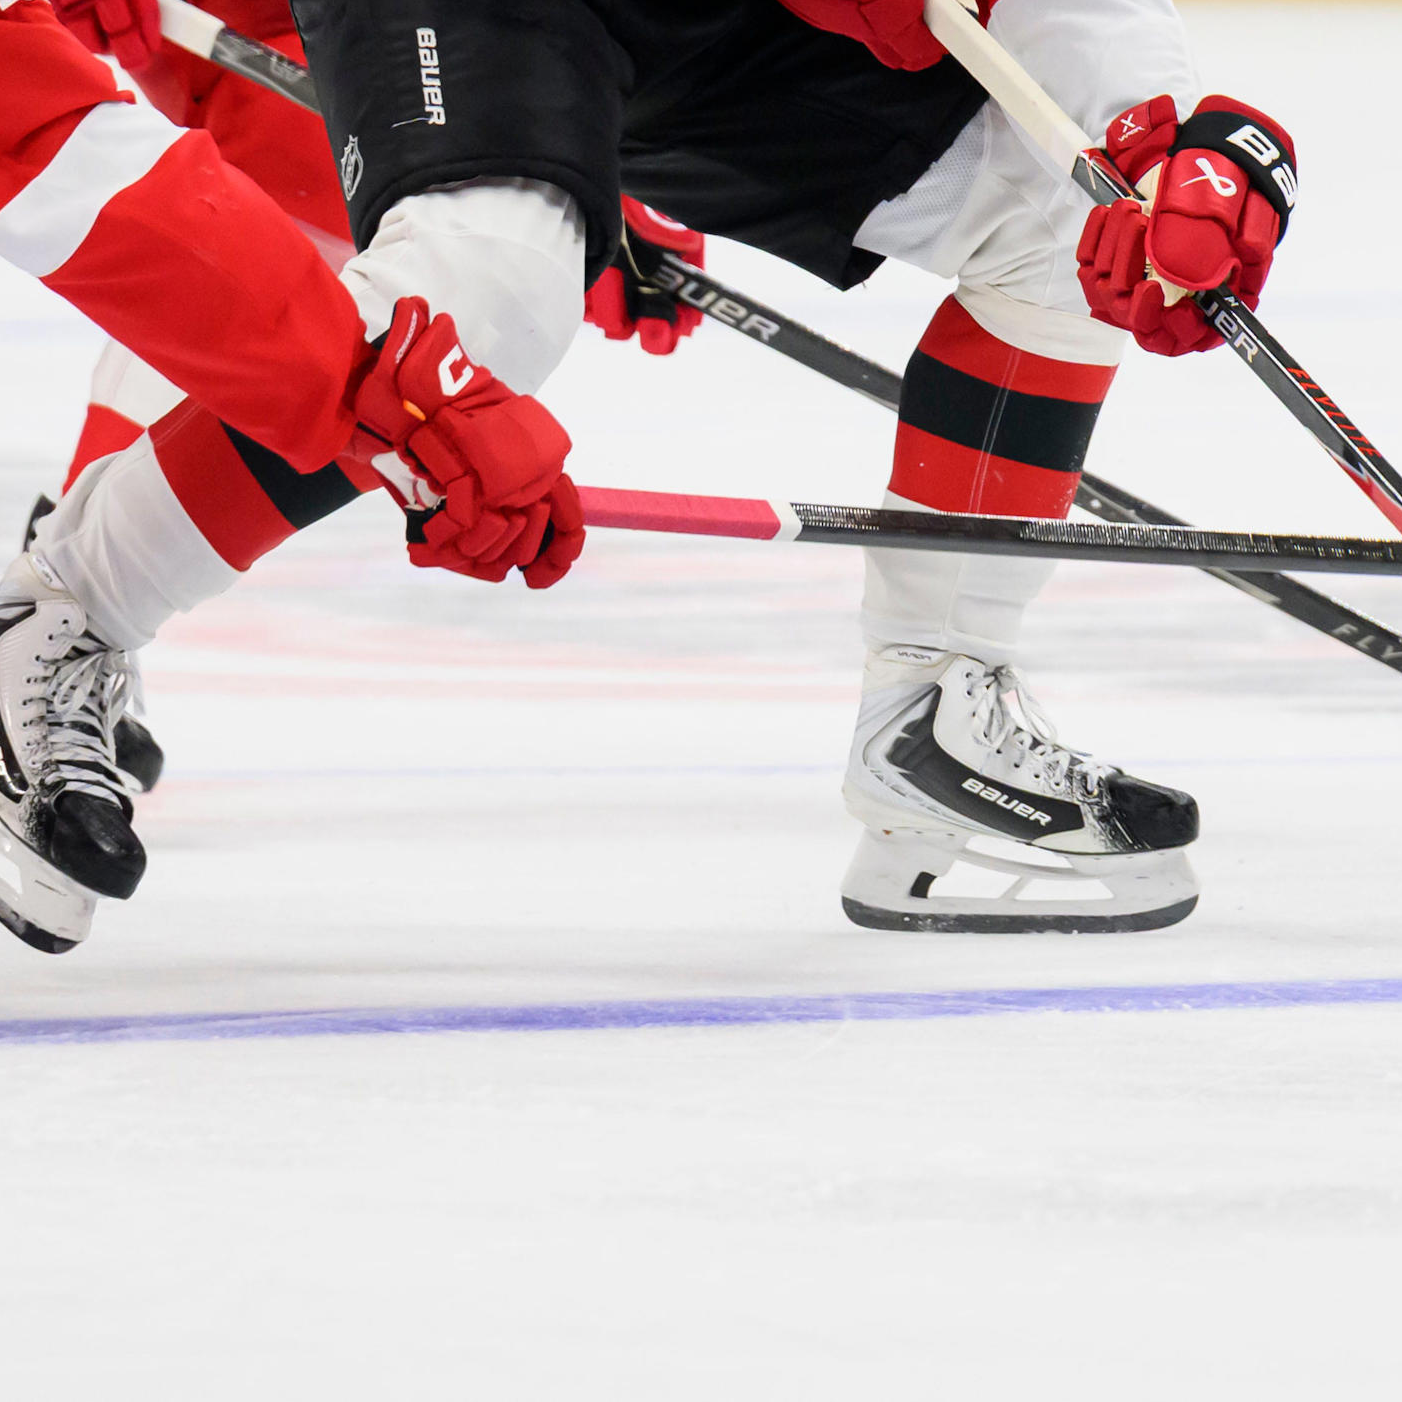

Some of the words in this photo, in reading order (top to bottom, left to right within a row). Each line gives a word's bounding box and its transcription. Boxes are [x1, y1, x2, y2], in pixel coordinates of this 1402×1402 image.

[415, 27, 446, 126] BAUER
[650, 262, 781, 342] AUER
[1285, 366, 1383, 459] FLYLITE
[961, 777, 1054, 828] BAUER
